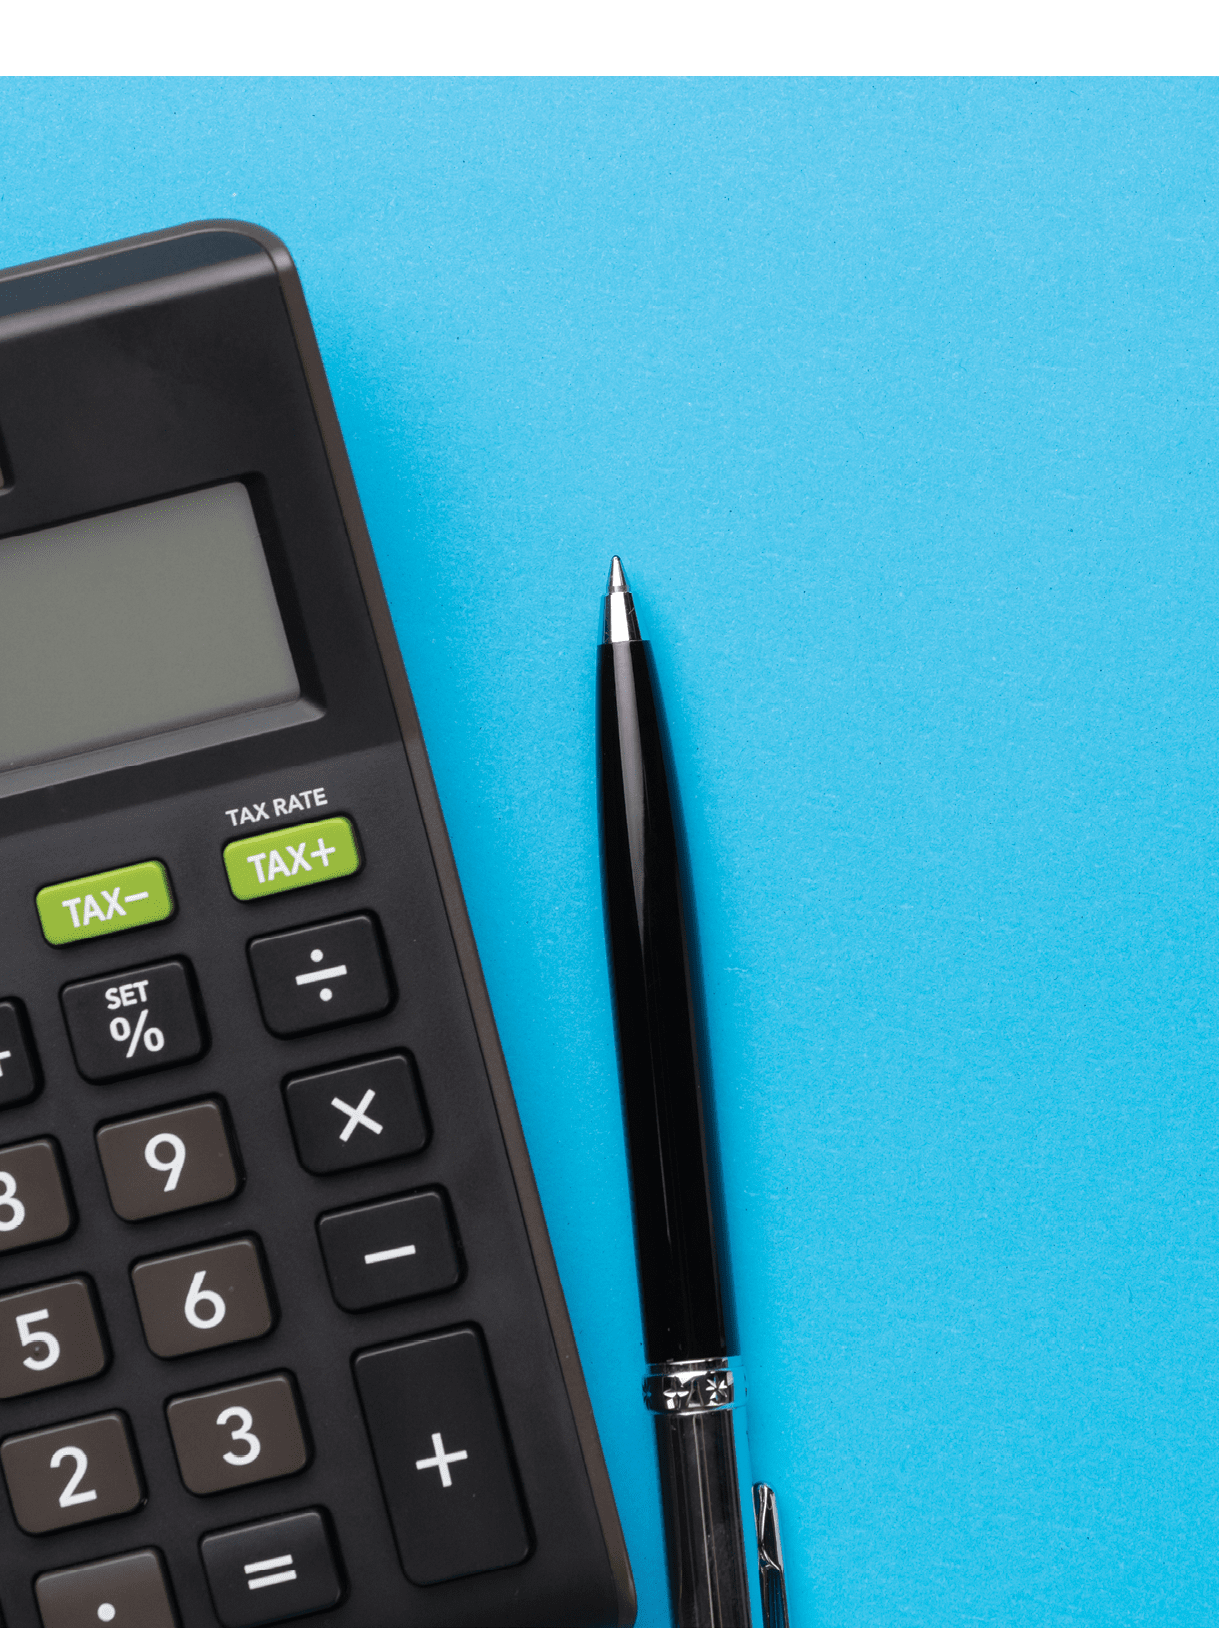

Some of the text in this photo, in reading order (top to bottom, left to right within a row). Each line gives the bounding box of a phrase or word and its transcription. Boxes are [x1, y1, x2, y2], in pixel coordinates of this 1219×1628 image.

[225, 787, 328, 826] TAX RATE
[246, 837, 336, 884] TAX+
[105, 980, 149, 1010] SET
[109, 1009, 165, 1058] %
[144, 1132, 186, 1192] 9
[184, 1270, 226, 1329] 6
[15, 1308, 60, 1371] 5
[216, 1406, 261, 1466] 3
[50, 1446, 97, 1508] 2
